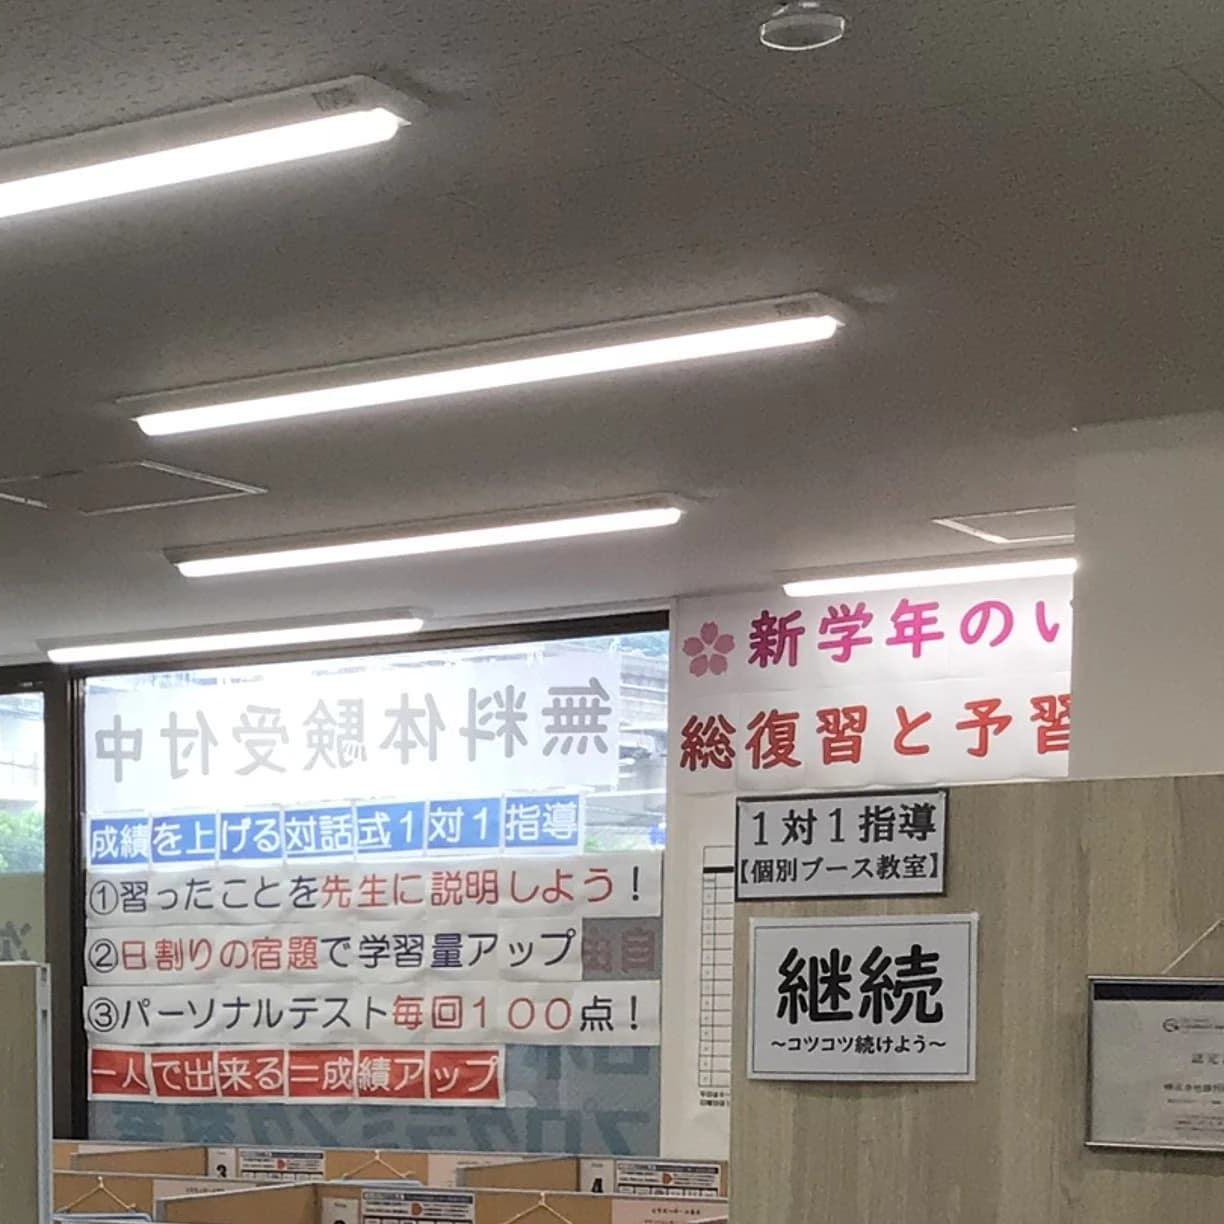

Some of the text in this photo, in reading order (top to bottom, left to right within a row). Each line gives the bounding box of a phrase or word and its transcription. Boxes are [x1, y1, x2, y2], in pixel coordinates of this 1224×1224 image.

[679, 694, 1071, 772] 総復習と予習
[89, 794, 580, 861] 成績を上げる対話式1対1指導
[752, 802, 936, 847] 1対1指導
[89, 866, 643, 916] ①習ったことを先生に説明しよう！
[740, 852, 939, 886] 【個別ブース教室】
[89, 926, 577, 973] ②日割りの宿題で学習量アップ
[777, 944, 943, 1025] 継続
[89, 991, 643, 1034] ③パーソナルテスト毎回100点！
